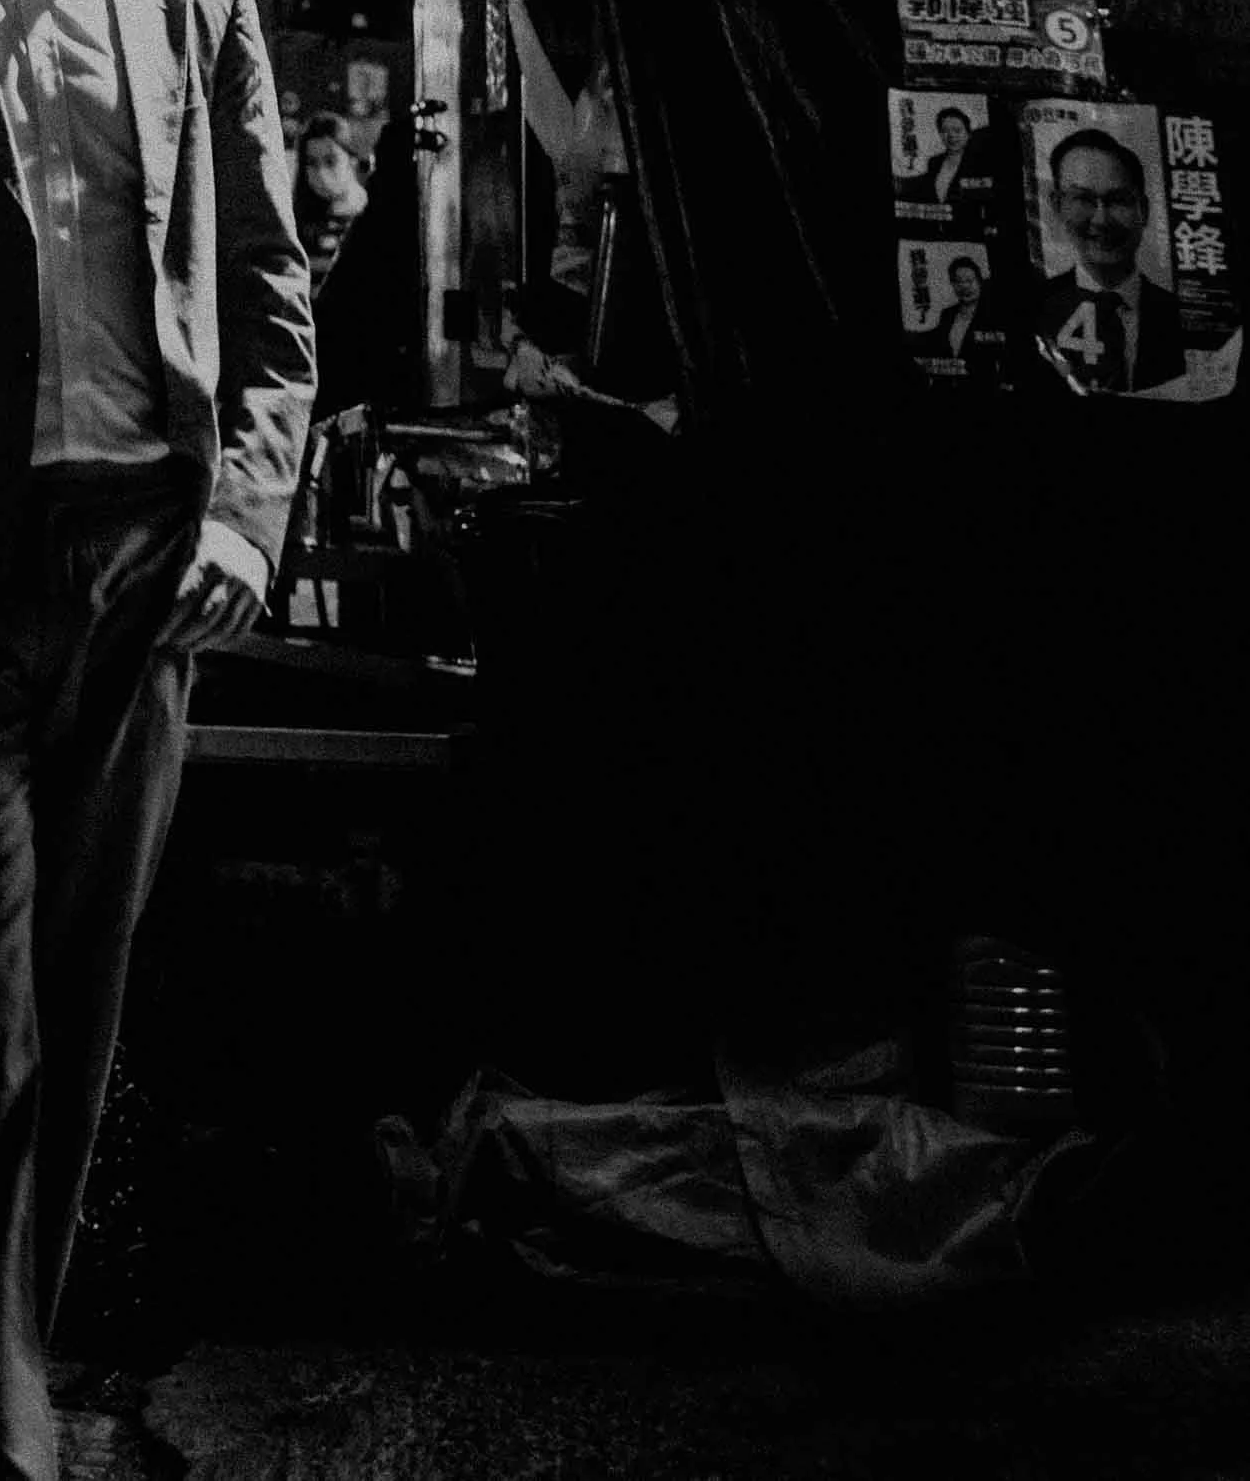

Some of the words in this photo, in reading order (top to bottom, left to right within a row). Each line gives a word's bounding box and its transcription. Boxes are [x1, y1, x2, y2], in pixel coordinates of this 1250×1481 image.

[1058, 16, 1077, 43] 5
[1164, 116, 1229, 276] 陳學鋒
[1056, 300, 1106, 366] 4
